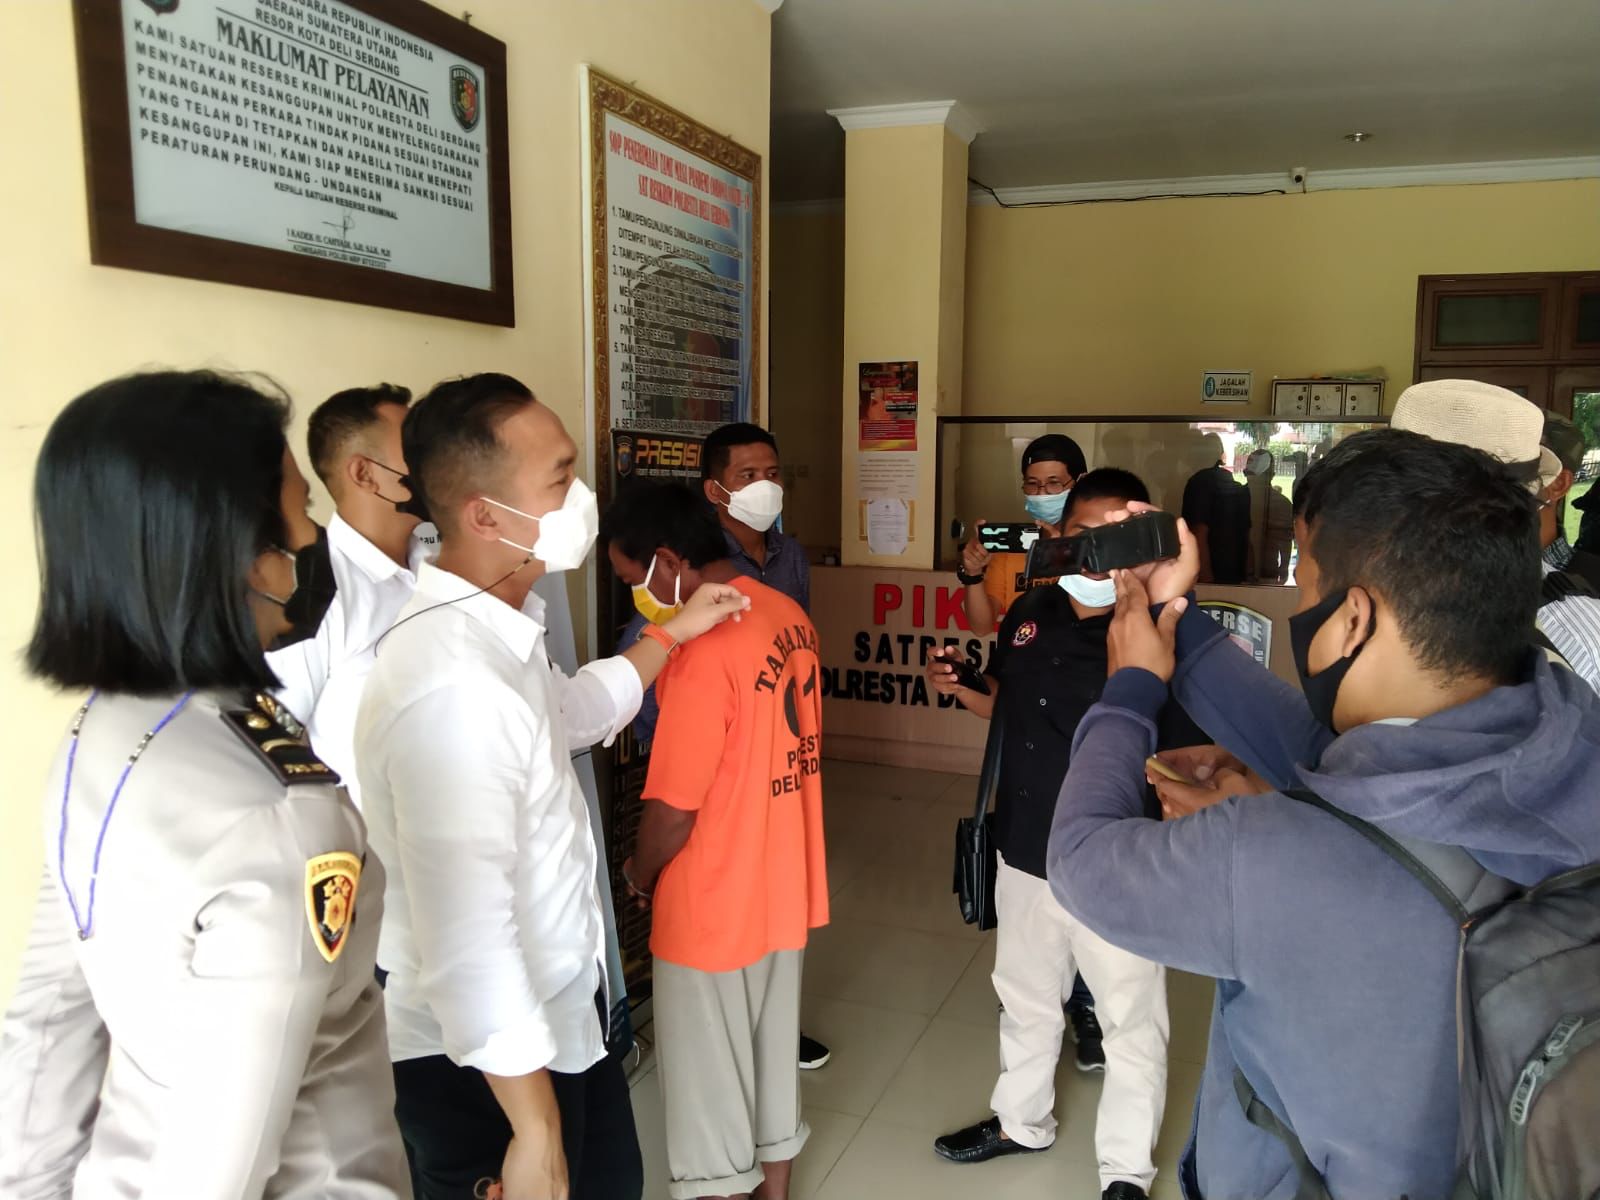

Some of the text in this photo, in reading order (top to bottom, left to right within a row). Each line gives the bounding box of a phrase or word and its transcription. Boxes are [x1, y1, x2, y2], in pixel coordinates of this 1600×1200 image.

[216, 16, 430, 119] MAKLUMAT PELAYANAN
[255, 8, 400, 76] RESOR KOTA DELI SERDANG
[307, 13, 363, 46] SUMATERA
[366, 38, 398, 61] UTARA
[331, 8, 382, 39] REPUBLIK
[384, 31, 434, 62] INDONESIA
[134, 19, 481, 153] KAMI SATUAN RESERSE KRIMINAL POLRESTA DELI SERDANG
[135, 40, 479, 169] MENYATAKAN KESANGGUPAN UNTUK MENYELENGGARAKAN
[137, 62, 473, 181] PENANGANAN PERKARA TINDAK PIDANA SESUAI STANDAR
[138, 84, 472, 197] YANG TELAH DI TETAPKAN DAN APABILA TIDAK MENEPATI
[139, 105, 473, 212] KESANGGUPAN INI, KAMI SIAP MENERIMA SANKSI SESUAI
[141, 127, 230, 164] PERATURAN
[234, 153, 311, 185] PERUNDANG
[321, 176, 382, 202] UNDANGAN
[274, 181, 398, 220] KEPALA SATUAN RESERSE KRIMINAL
[618, 227, 647, 245] DITEMPAT
[1215, 378, 1249, 397] JAGALAH KEBERSIHAN
[635, 438, 702, 468] PRESISI
[873, 583, 1003, 632] PIK
[1201, 609, 1263, 642] ERSE
[755, 624, 819, 694] TAHANA
